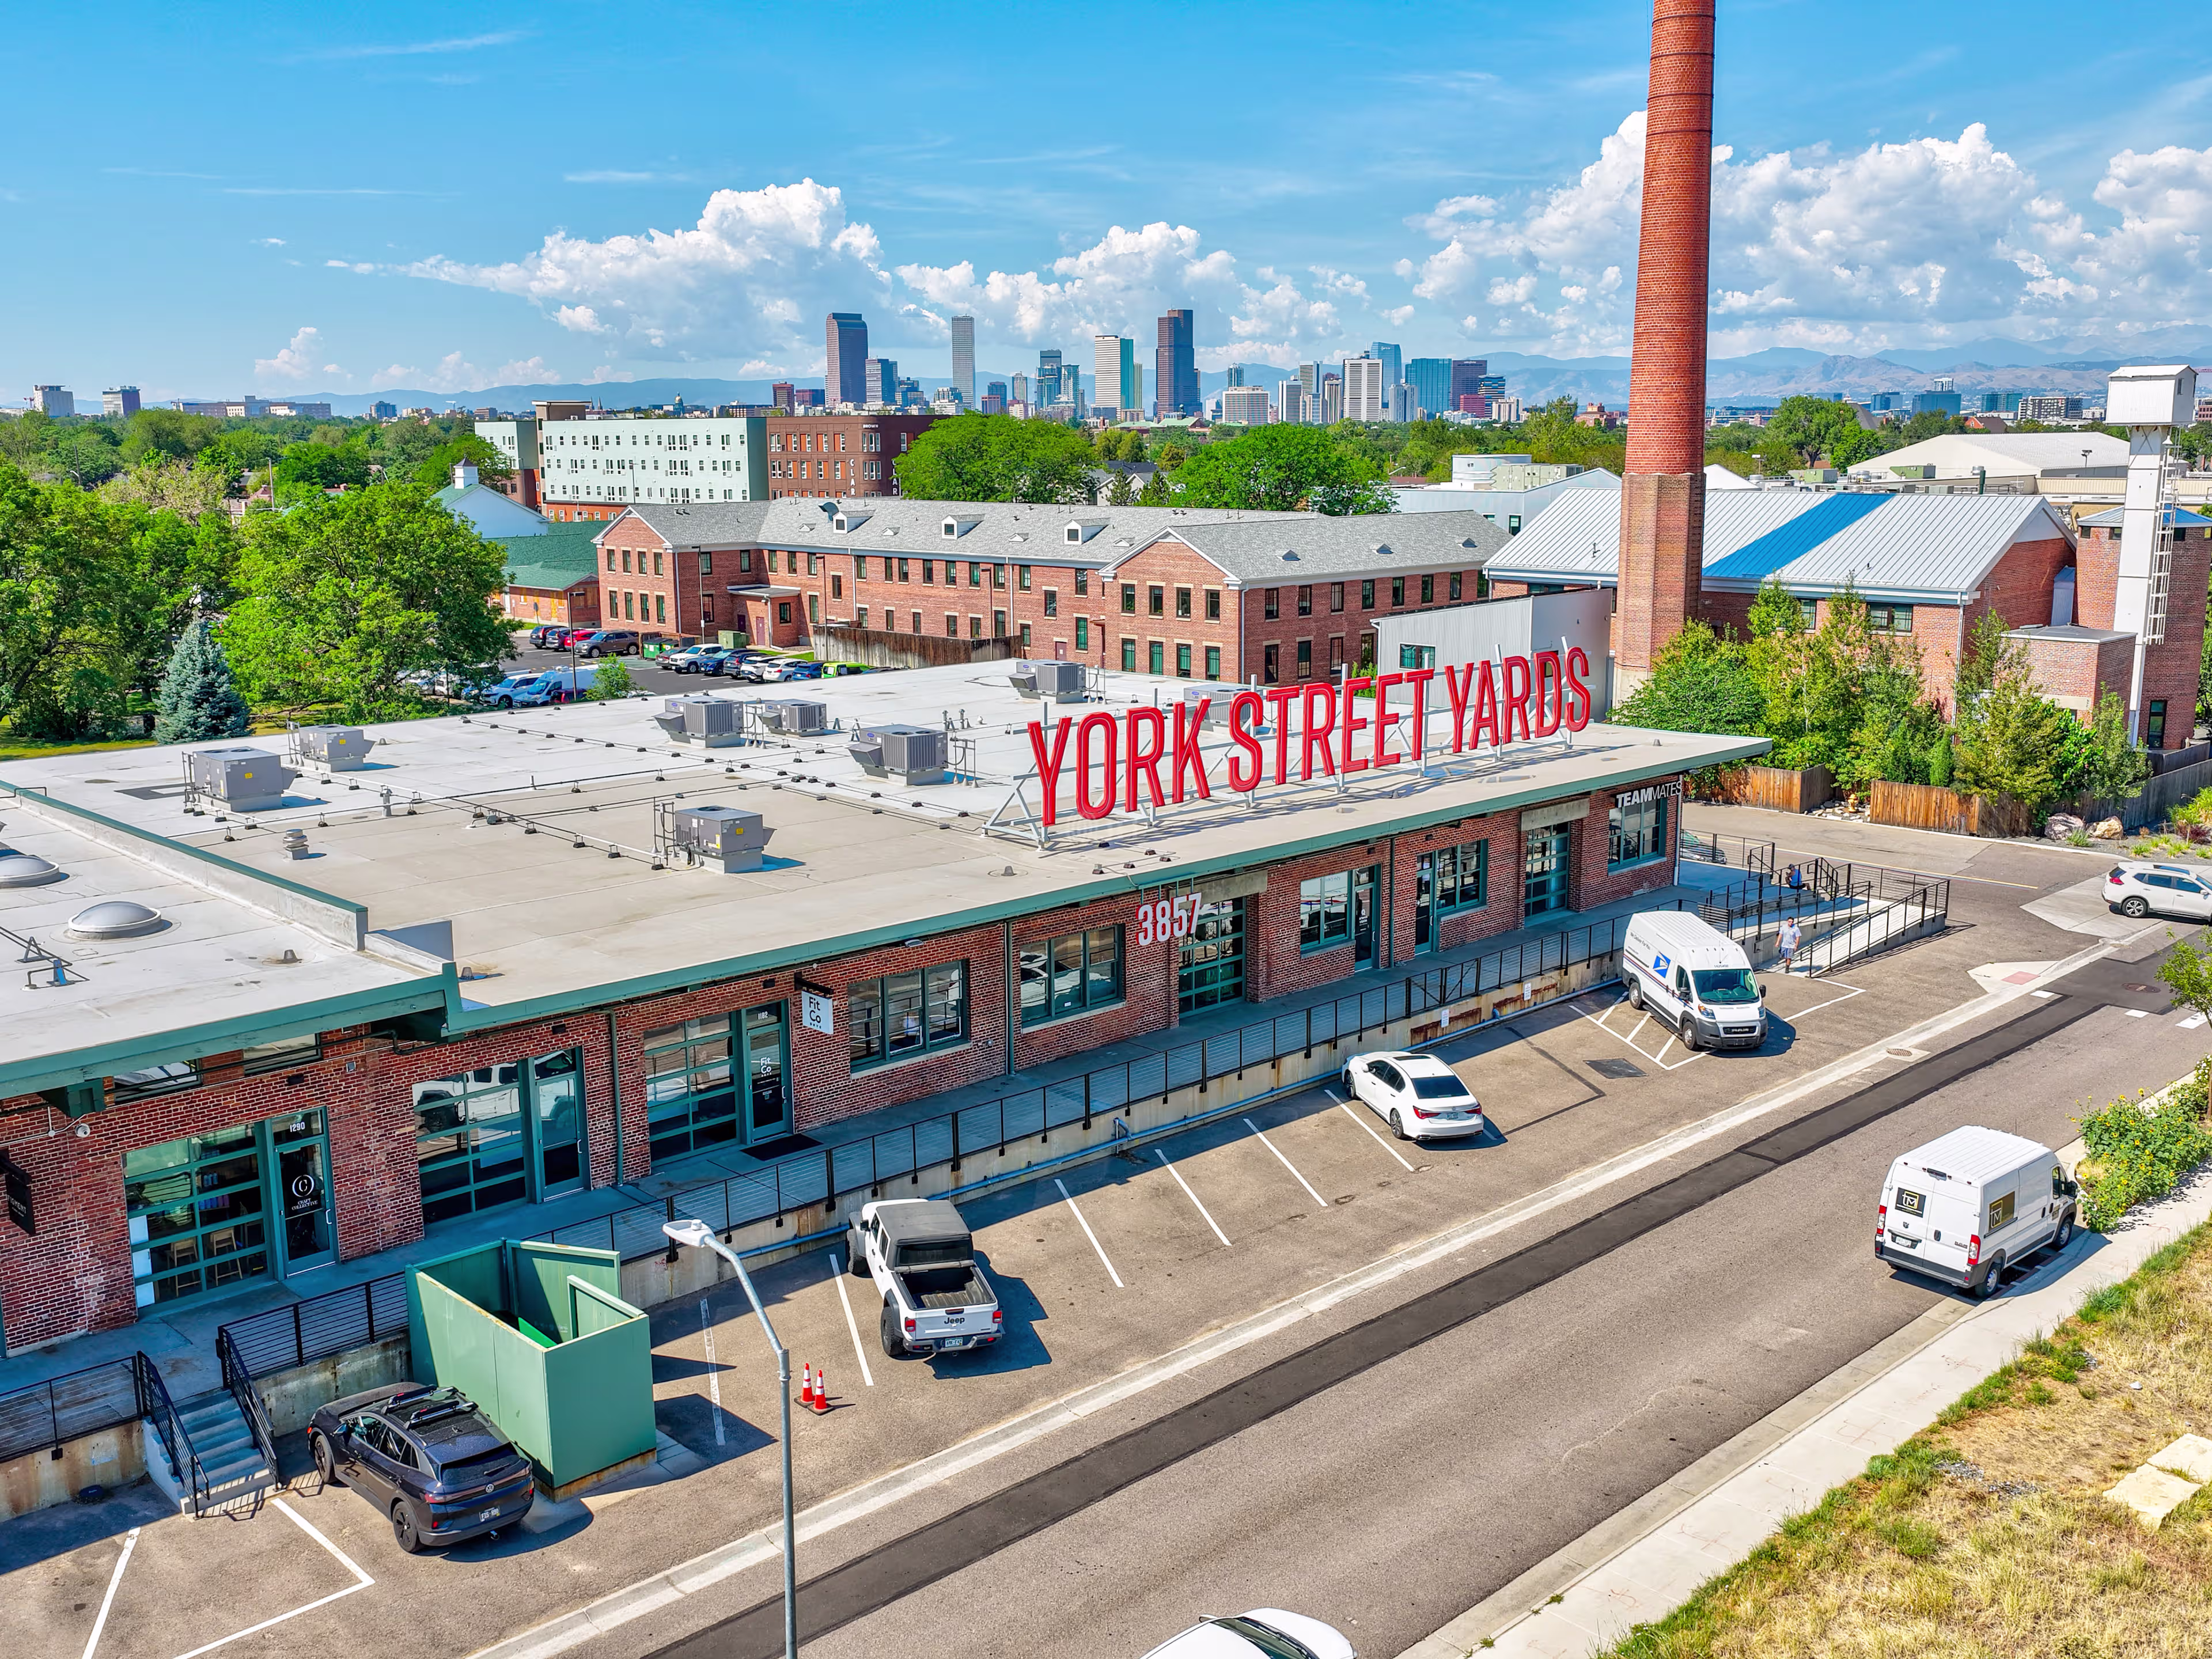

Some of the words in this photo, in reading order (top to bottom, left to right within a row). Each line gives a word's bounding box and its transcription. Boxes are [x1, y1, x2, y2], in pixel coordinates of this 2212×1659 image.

[1028, 699, 1211, 827] YORK
[1229, 669, 1434, 792] STREET
[1446, 647, 1591, 753] YARDS
[1616, 780, 1681, 808] TEAMMATES
[1135, 892, 1202, 946] 3857
[809, 997, 820, 1010] Fit
[809, 1010, 821, 1023] Co
[760, 1057, 771, 1066] Fit
[760, 1065, 771, 1074] Co
[290, 1122, 305, 1132] 1290
[291, 1200, 319, 1210] COLLECTIVE
